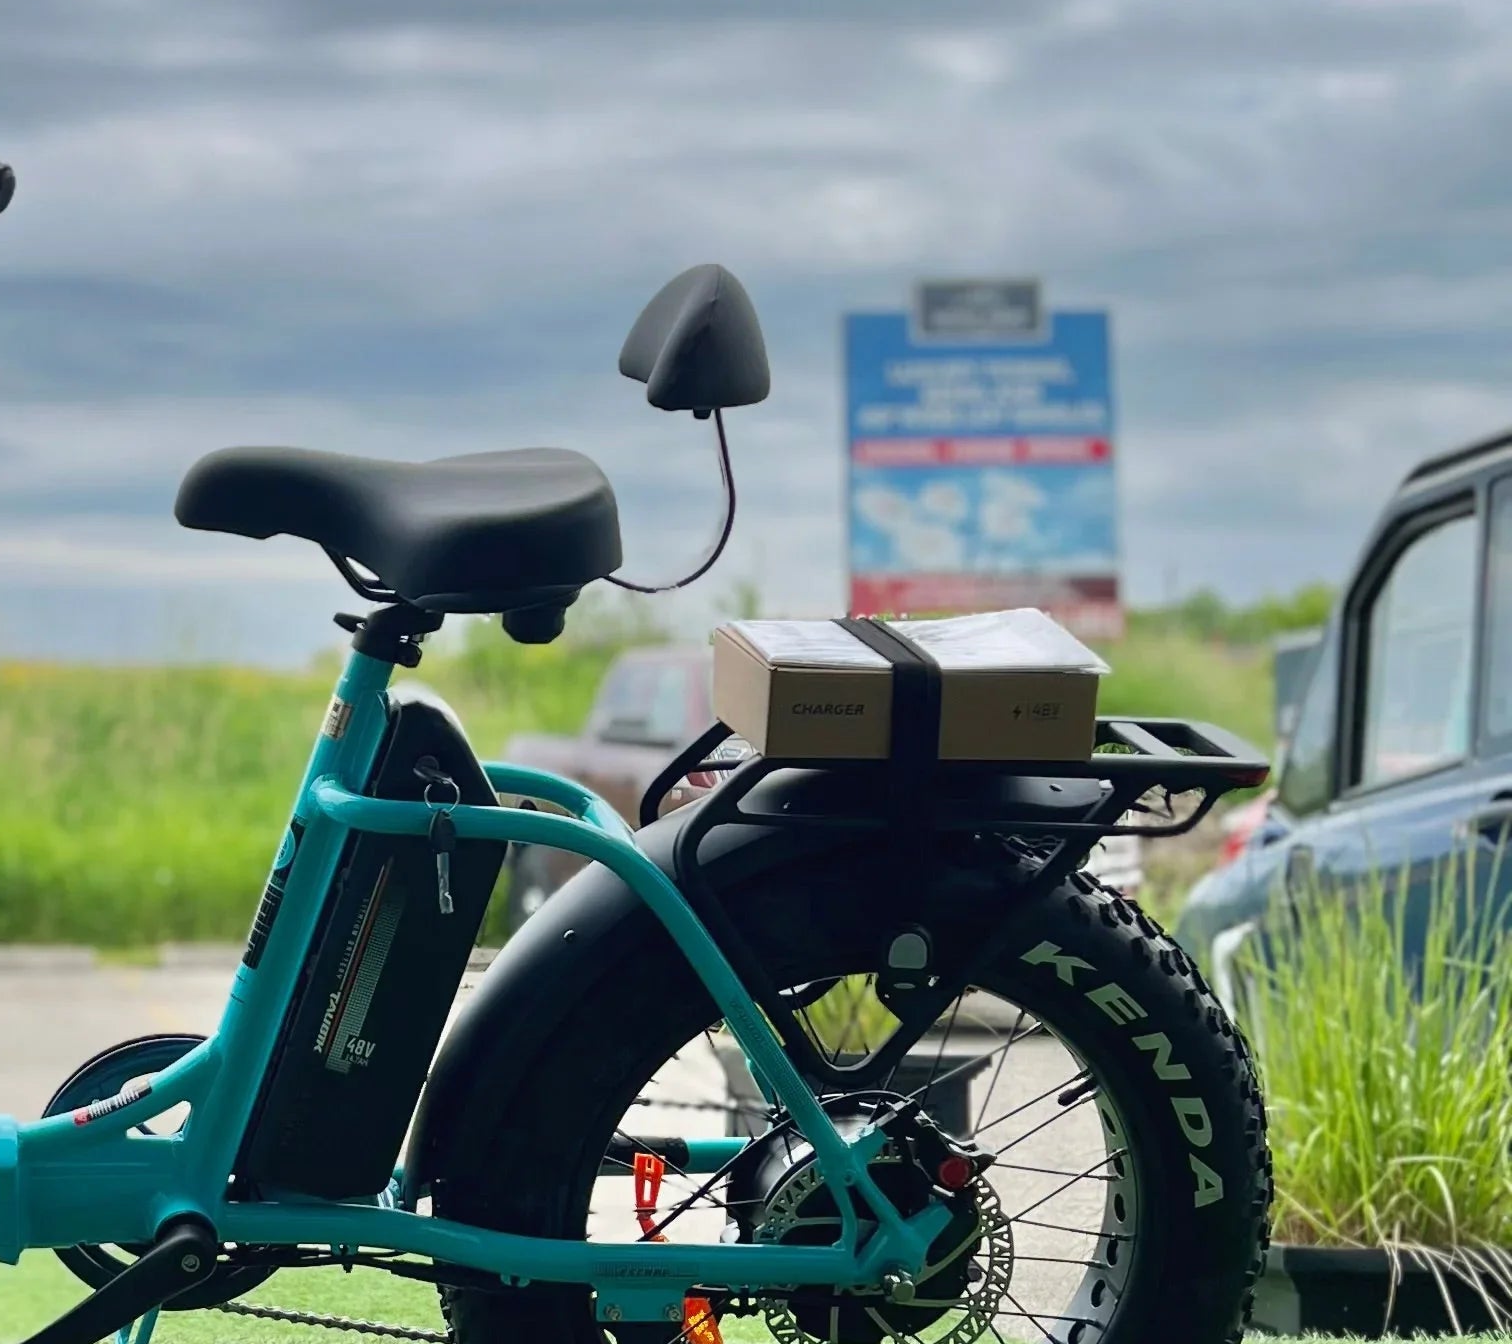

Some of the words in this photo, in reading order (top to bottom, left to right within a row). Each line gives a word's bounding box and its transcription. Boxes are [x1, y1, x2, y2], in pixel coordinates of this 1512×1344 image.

[791, 703, 865, 716] CHARGER
[313, 991, 342, 1054] TAUBIK
[346, 1037, 376, 1058] 48V
[1019, 940, 1225, 1208] KENDA
